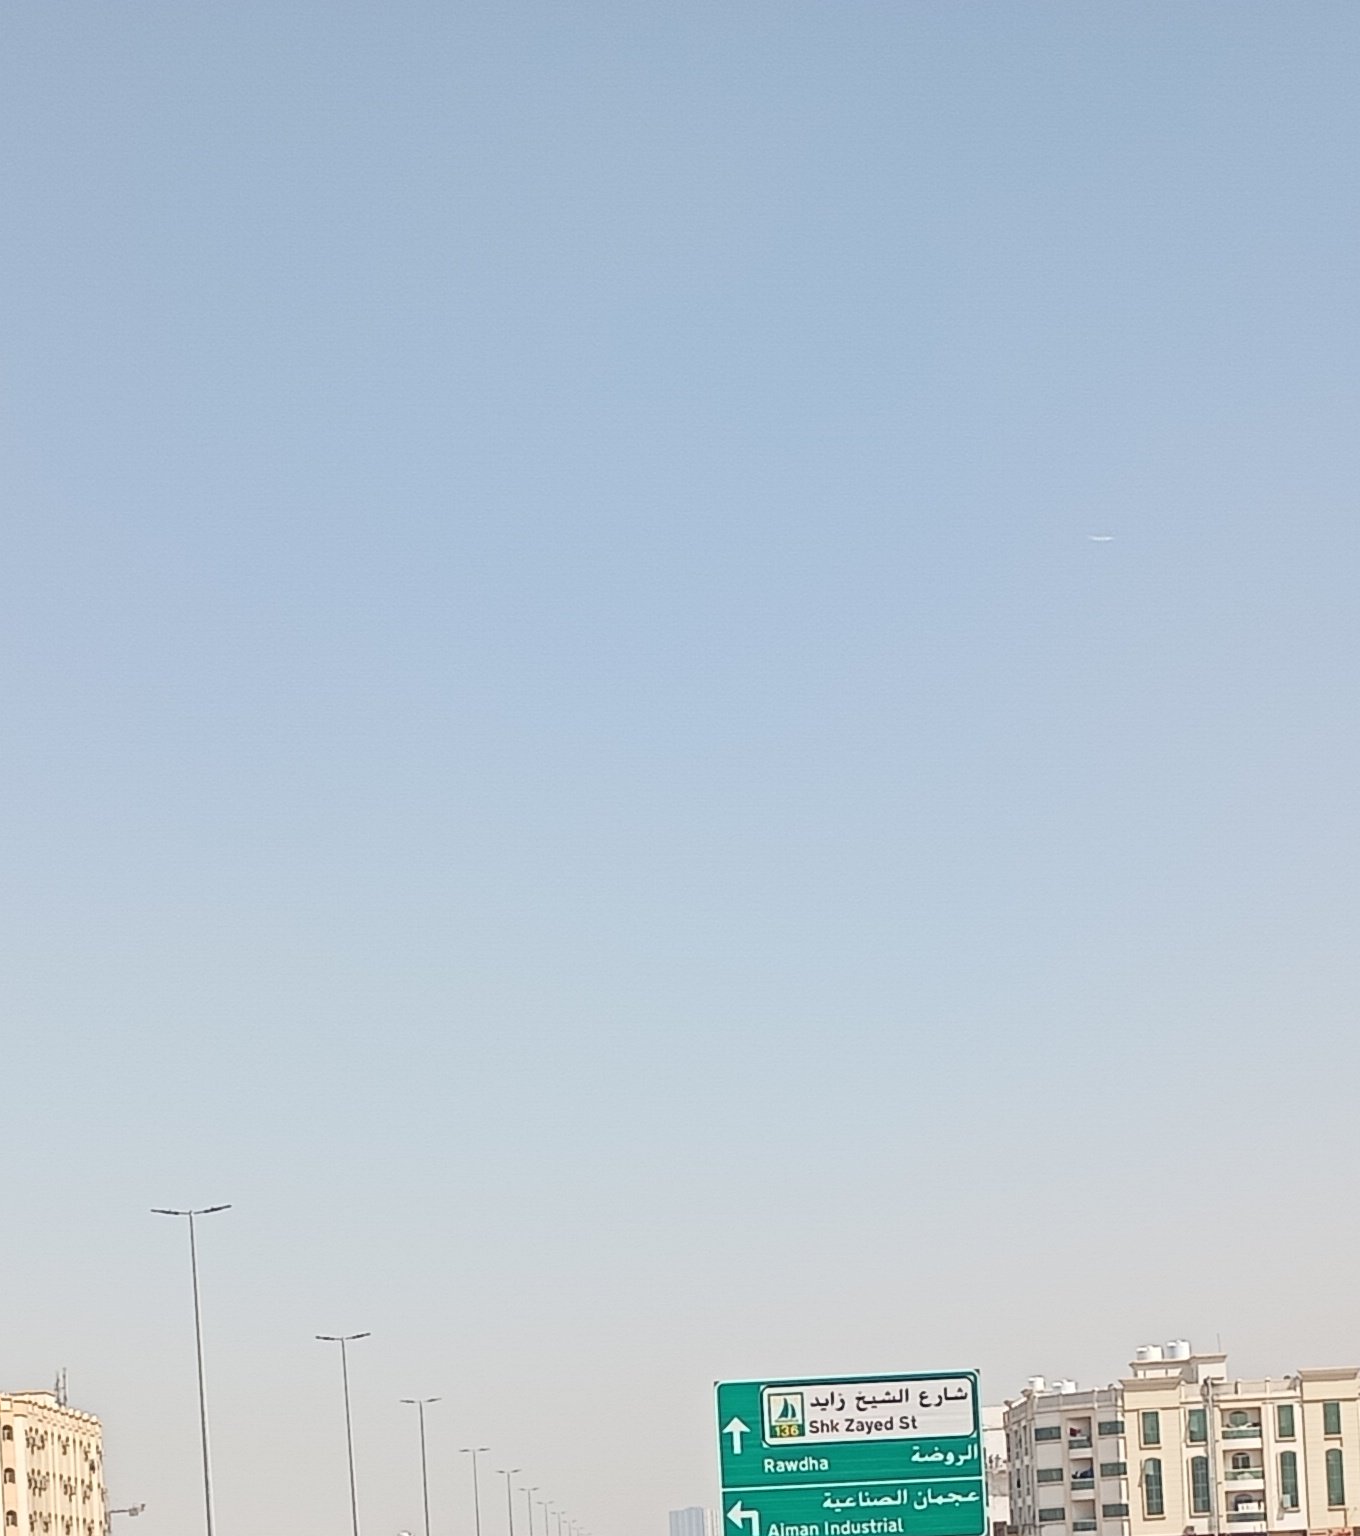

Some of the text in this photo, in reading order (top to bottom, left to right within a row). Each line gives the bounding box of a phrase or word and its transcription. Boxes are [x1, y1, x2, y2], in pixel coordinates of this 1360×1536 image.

[809, 1387, 969, 1412] شارع الشيخ زايد
[773, 1424, 800, 1437] 136
[808, 1415, 918, 1434] Shk Zayed St
[910, 1443, 979, 1466] الروضة
[763, 1456, 829, 1473] Rawdha
[822, 1489, 981, 1510] عجمان الصناعية
[824, 1518, 904, 1535] Industrial
